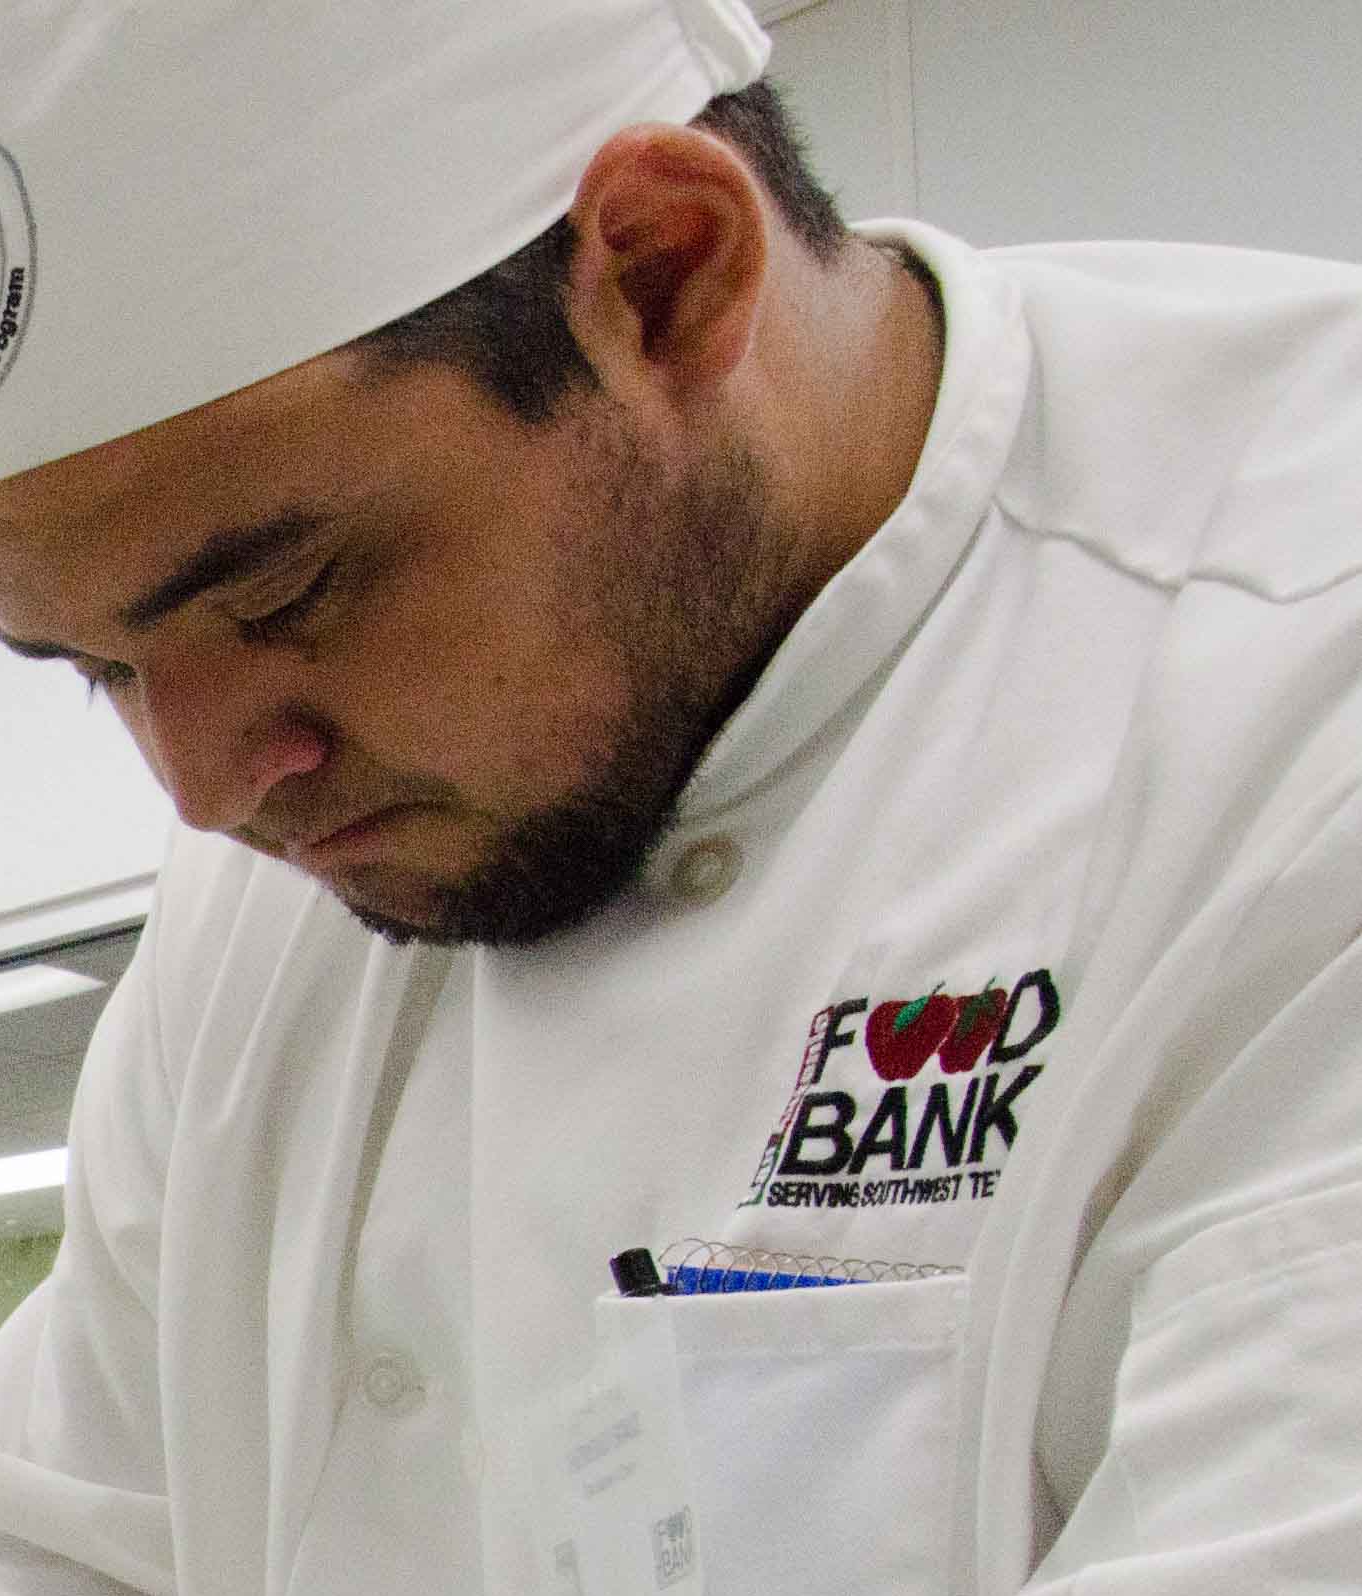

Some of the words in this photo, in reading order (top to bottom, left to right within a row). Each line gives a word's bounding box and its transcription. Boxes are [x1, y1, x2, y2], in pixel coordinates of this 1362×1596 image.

[777, 1064, 1045, 1176] BANK
[767, 1179, 861, 1208] SERVING
[861, 1172, 963, 1208] SOUTHWEST
[969, 1169, 1002, 1201] TE
